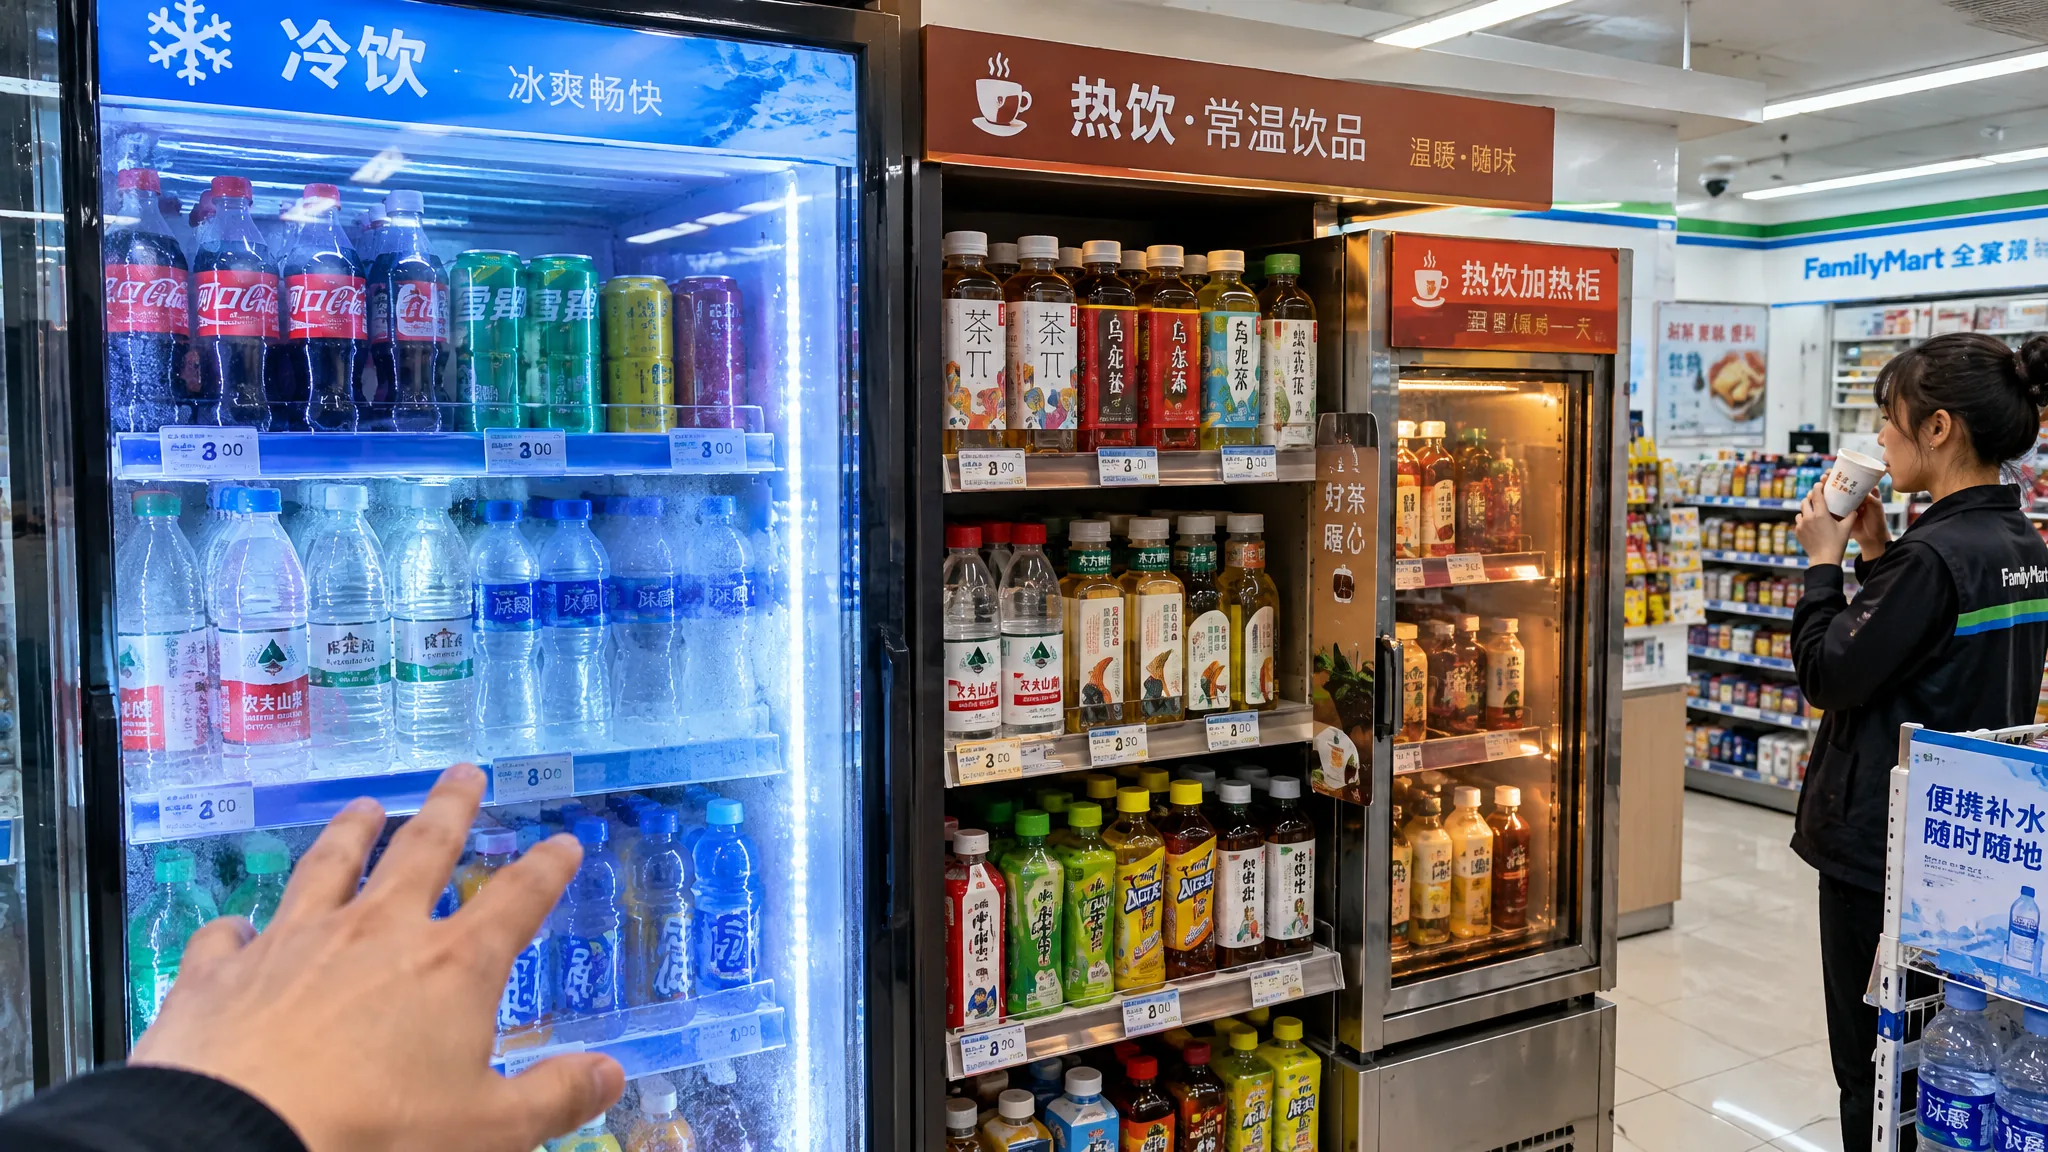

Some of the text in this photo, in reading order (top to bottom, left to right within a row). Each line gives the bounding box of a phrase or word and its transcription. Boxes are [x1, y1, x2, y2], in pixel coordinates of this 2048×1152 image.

[280, 17, 428, 98] 冷饮
[508, 65, 663, 117] 冰爽畅快
[1804, 246, 1944, 280] FamilyMart
[1923, 817, 2043, 872] 随时随地
